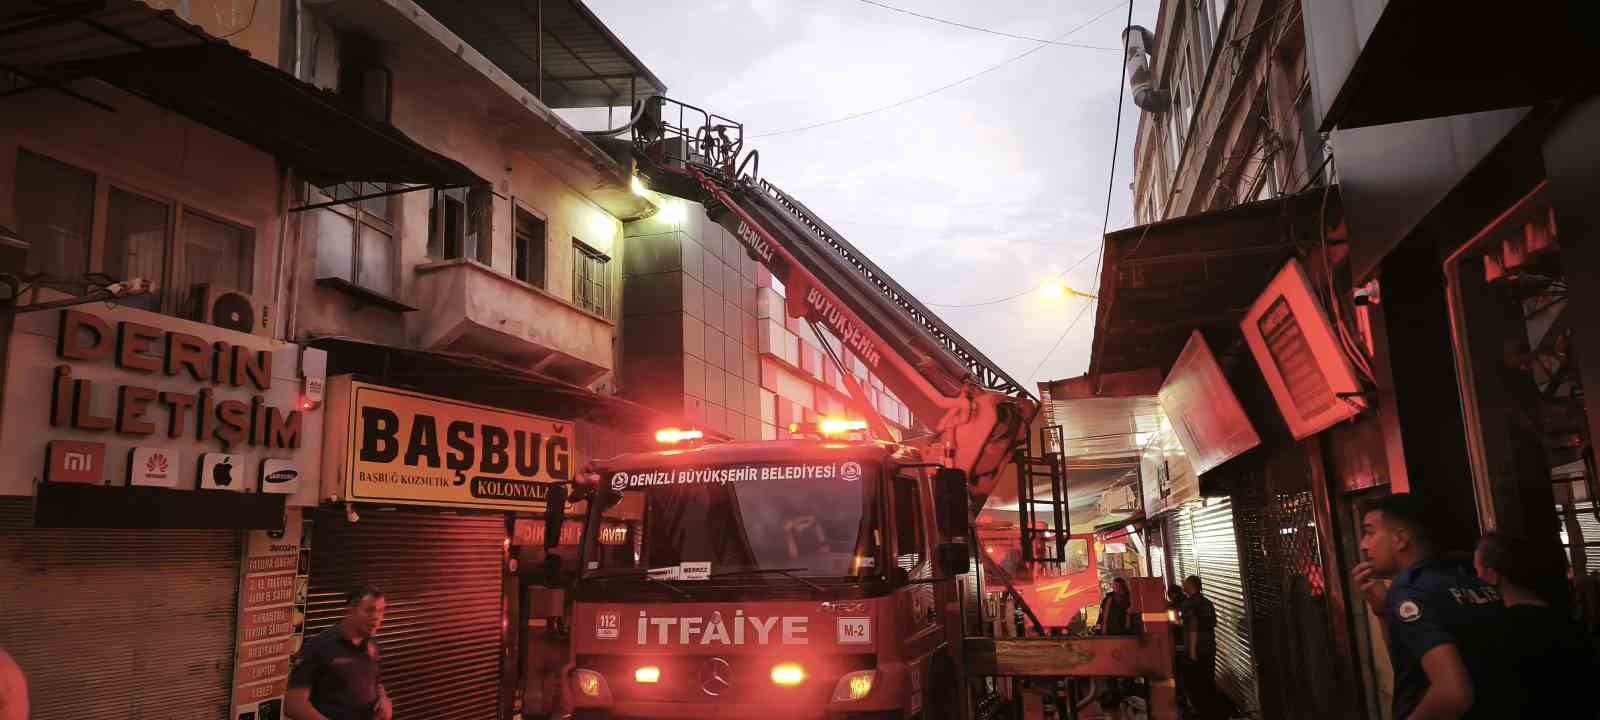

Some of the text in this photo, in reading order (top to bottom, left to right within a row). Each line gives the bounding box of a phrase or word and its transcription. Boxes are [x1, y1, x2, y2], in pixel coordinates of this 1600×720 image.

[56, 309, 272, 390] DERİN
[50, 364, 302, 452] İLETİŞİM
[360, 406, 568, 486] BAŞBUĞ
[359, 471, 449, 487] BAŞBUĞ KOZMETİK
[630, 462, 836, 486] DENİZLİ BÜYÜKŞEHİR BELEDİYESİ
[600, 614, 616, 628] 112
[638, 609, 809, 645] İTFAİYE
[844, 624, 865, 637] M-2
